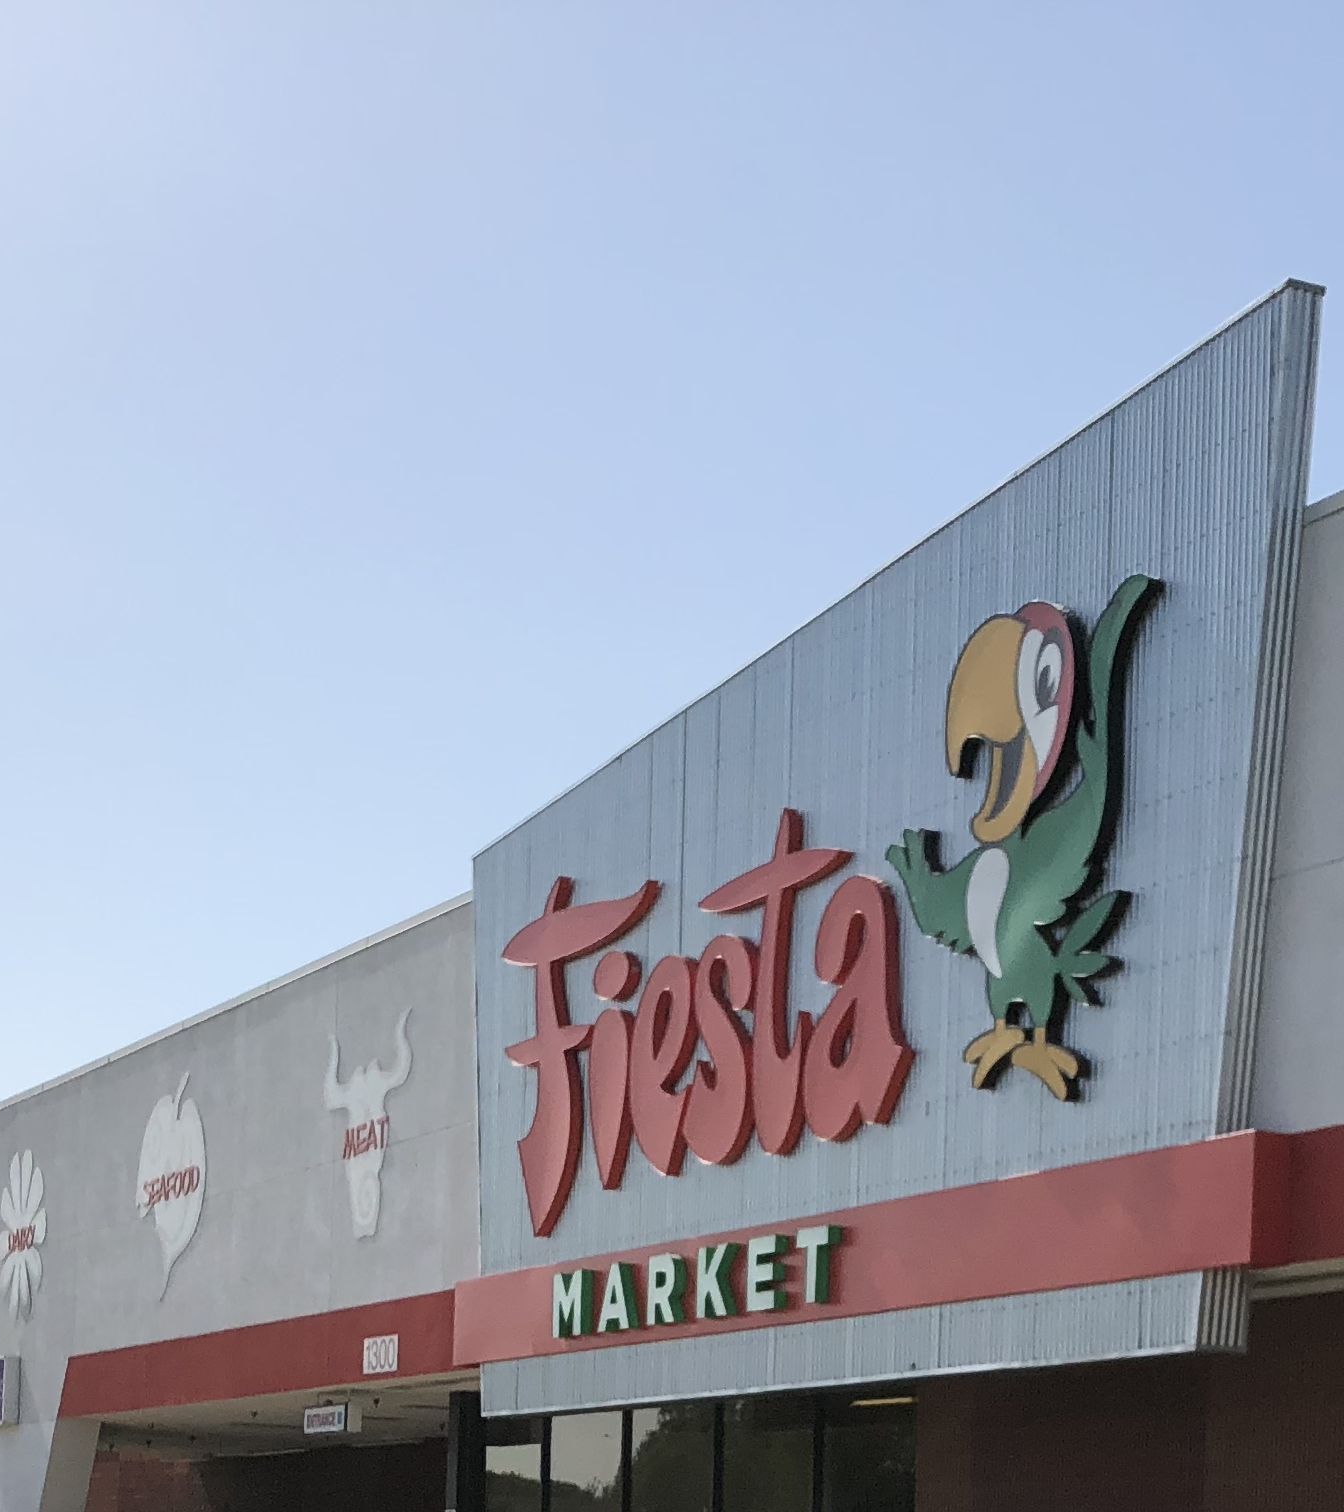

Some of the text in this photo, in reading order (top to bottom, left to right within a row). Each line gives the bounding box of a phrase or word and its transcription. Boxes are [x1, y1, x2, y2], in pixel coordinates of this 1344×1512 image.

[502, 807, 915, 1237] Fiesta
[342, 1115, 390, 1160] MEAT
[143, 1165, 200, 1206] SEAFOOD
[8, 1224, 36, 1255] DAIRY
[553, 1224, 843, 1339] MARKET
[366, 1338, 395, 1370] 1300
